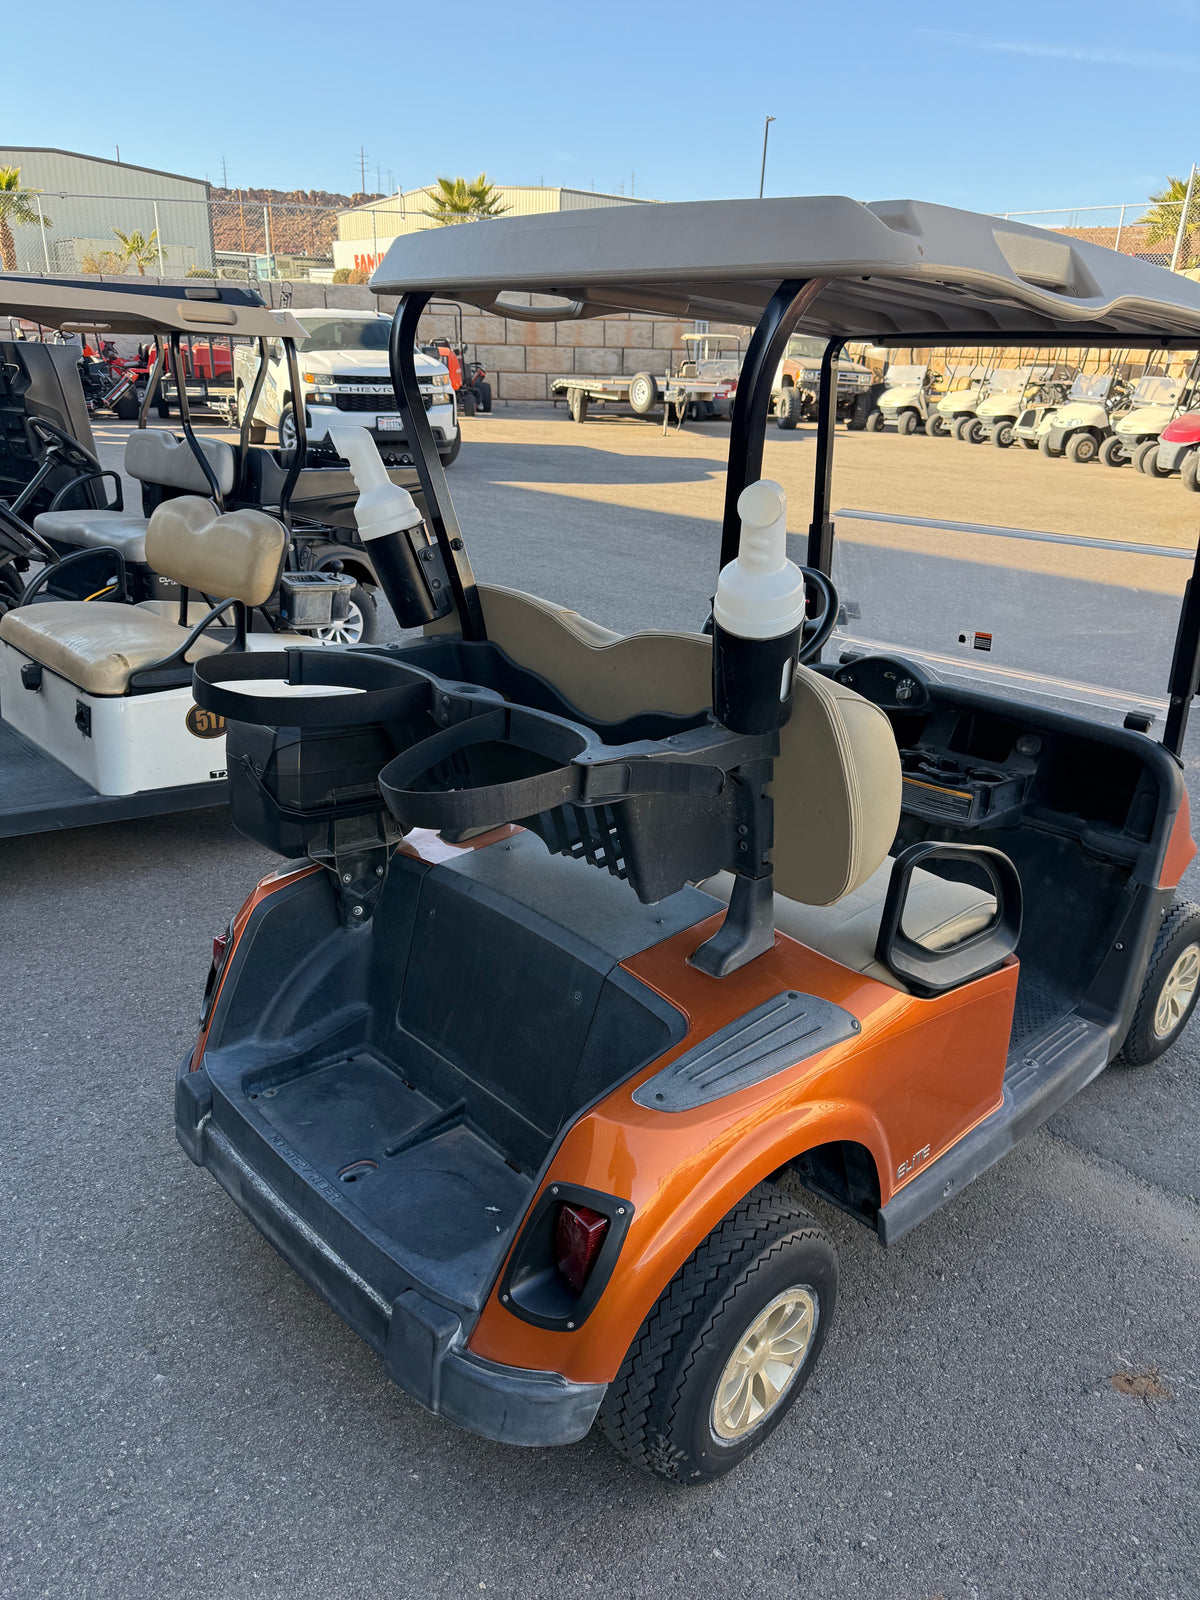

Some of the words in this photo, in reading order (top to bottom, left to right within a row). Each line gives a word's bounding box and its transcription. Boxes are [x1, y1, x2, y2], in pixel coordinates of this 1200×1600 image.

[271, 1134, 286, 1148] NO
[282, 1147, 310, 1168] STEP
[309, 1173, 343, 1201] RIDER
